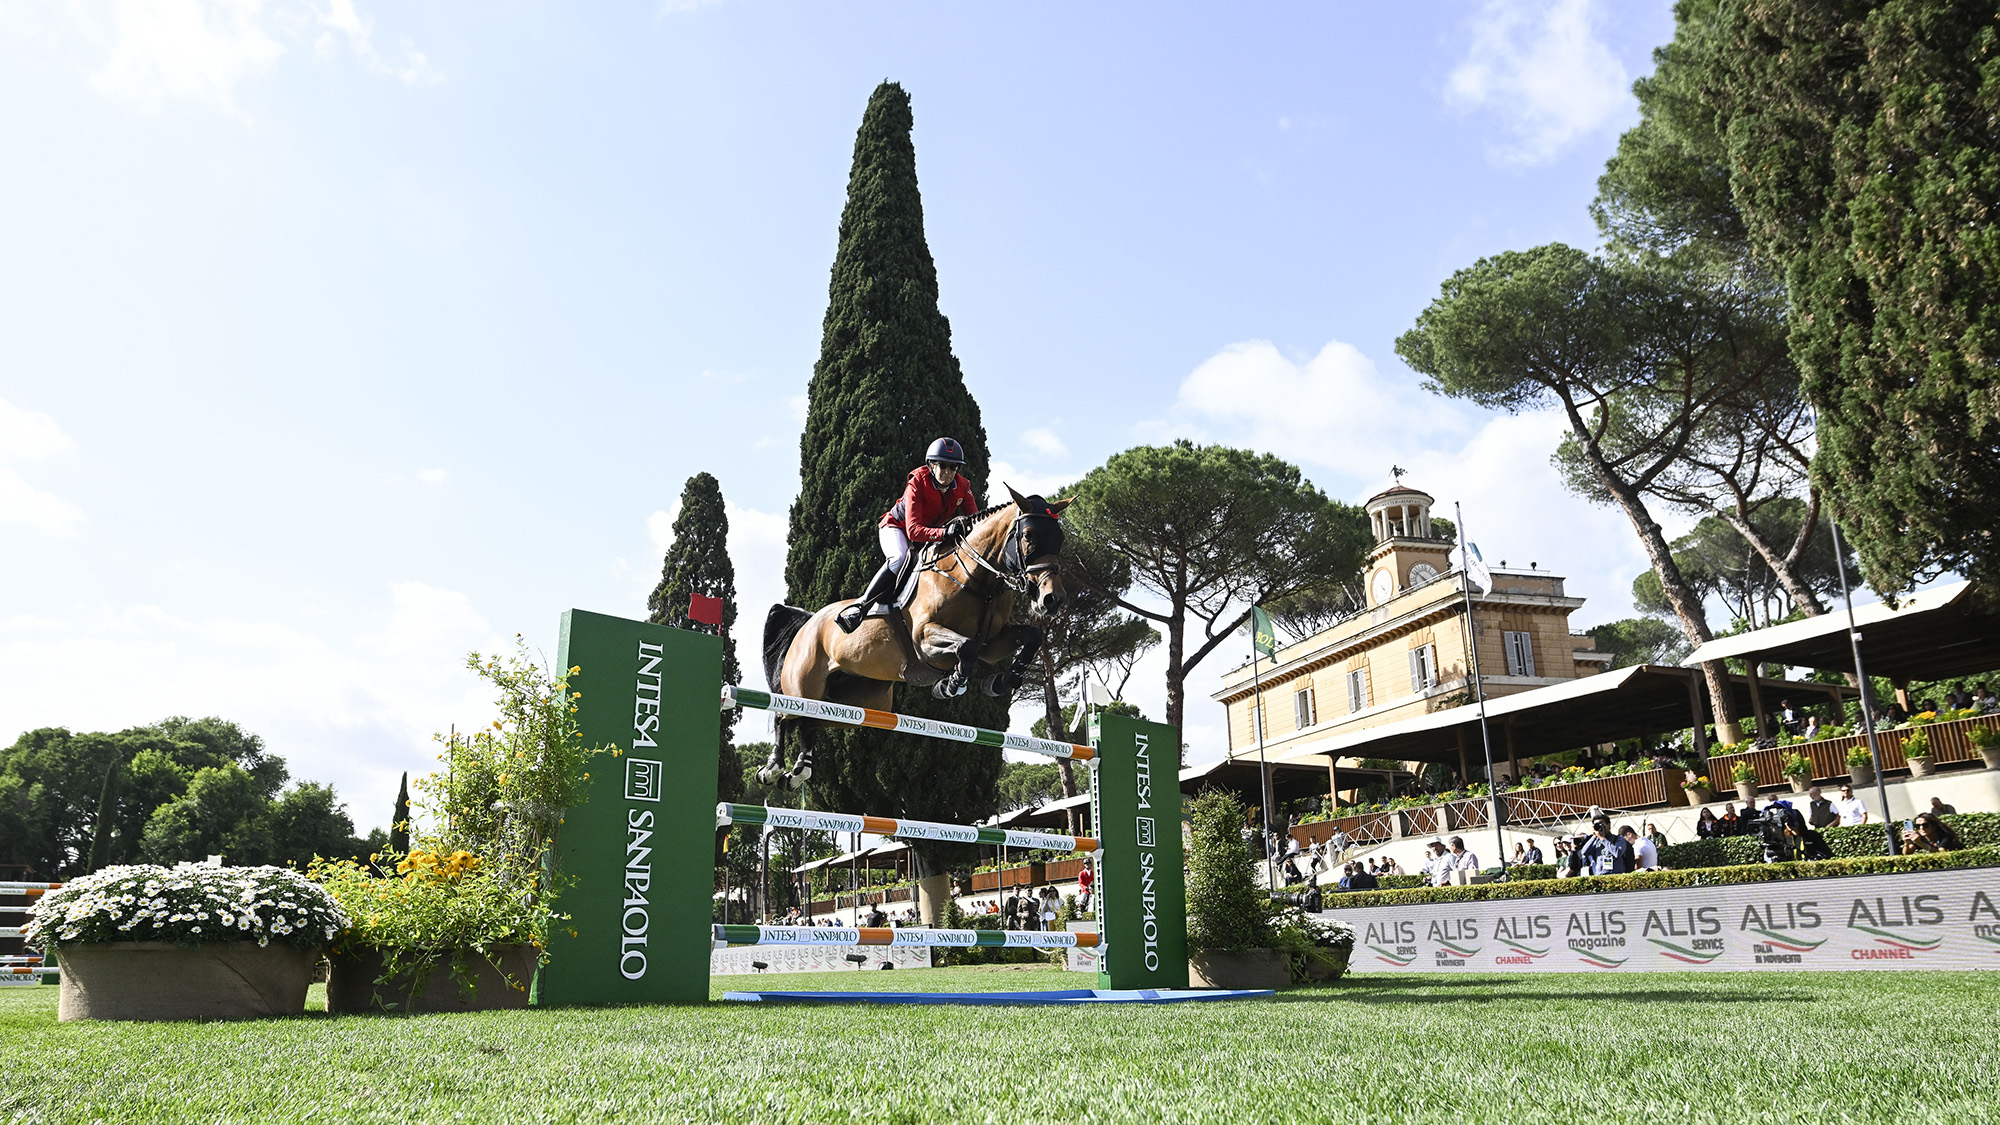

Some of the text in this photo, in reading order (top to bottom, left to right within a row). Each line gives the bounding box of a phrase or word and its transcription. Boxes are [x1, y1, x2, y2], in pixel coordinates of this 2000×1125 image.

[773, 697, 862, 721] INTESA SANPAOLO
[900, 718, 975, 738] INTESA SANPAOLO
[1006, 736, 1071, 754] INTESA SANPAOLO
[620, 639, 663, 980] INTESA SANPAOLO
[770, 815, 861, 830] INTESA SANPAOLO
[899, 826, 976, 841] INTESA SANPAOLO
[1006, 836, 1074, 850] INTESA SANPAOLO
[1135, 731, 1159, 972] INTESA SANPAOLO
[1740, 901, 1822, 931] ALIS
[1847, 894, 1945, 928] ALIS
[1428, 918, 1478, 941] ALIS
[1493, 915, 1551, 939] ALIS
[1566, 910, 1626, 936] ALIS
[1642, 907, 1721, 937] ALIS
[764, 930, 857, 942] INTESA SANPAOLO
[896, 932, 975, 943] INTESA SANPAOLO
[1008, 934, 1075, 944] INTESA SANPAOLO
[1364, 921, 1415, 944] ALIS
[1397, 946, 1417, 955] SERVICE
[1568, 935, 1625, 950] magazine
[1692, 938, 1724, 950] SERVICE
[1495, 956, 1533, 964] CHANNEL
[1851, 949, 1915, 960] CHANNEL
